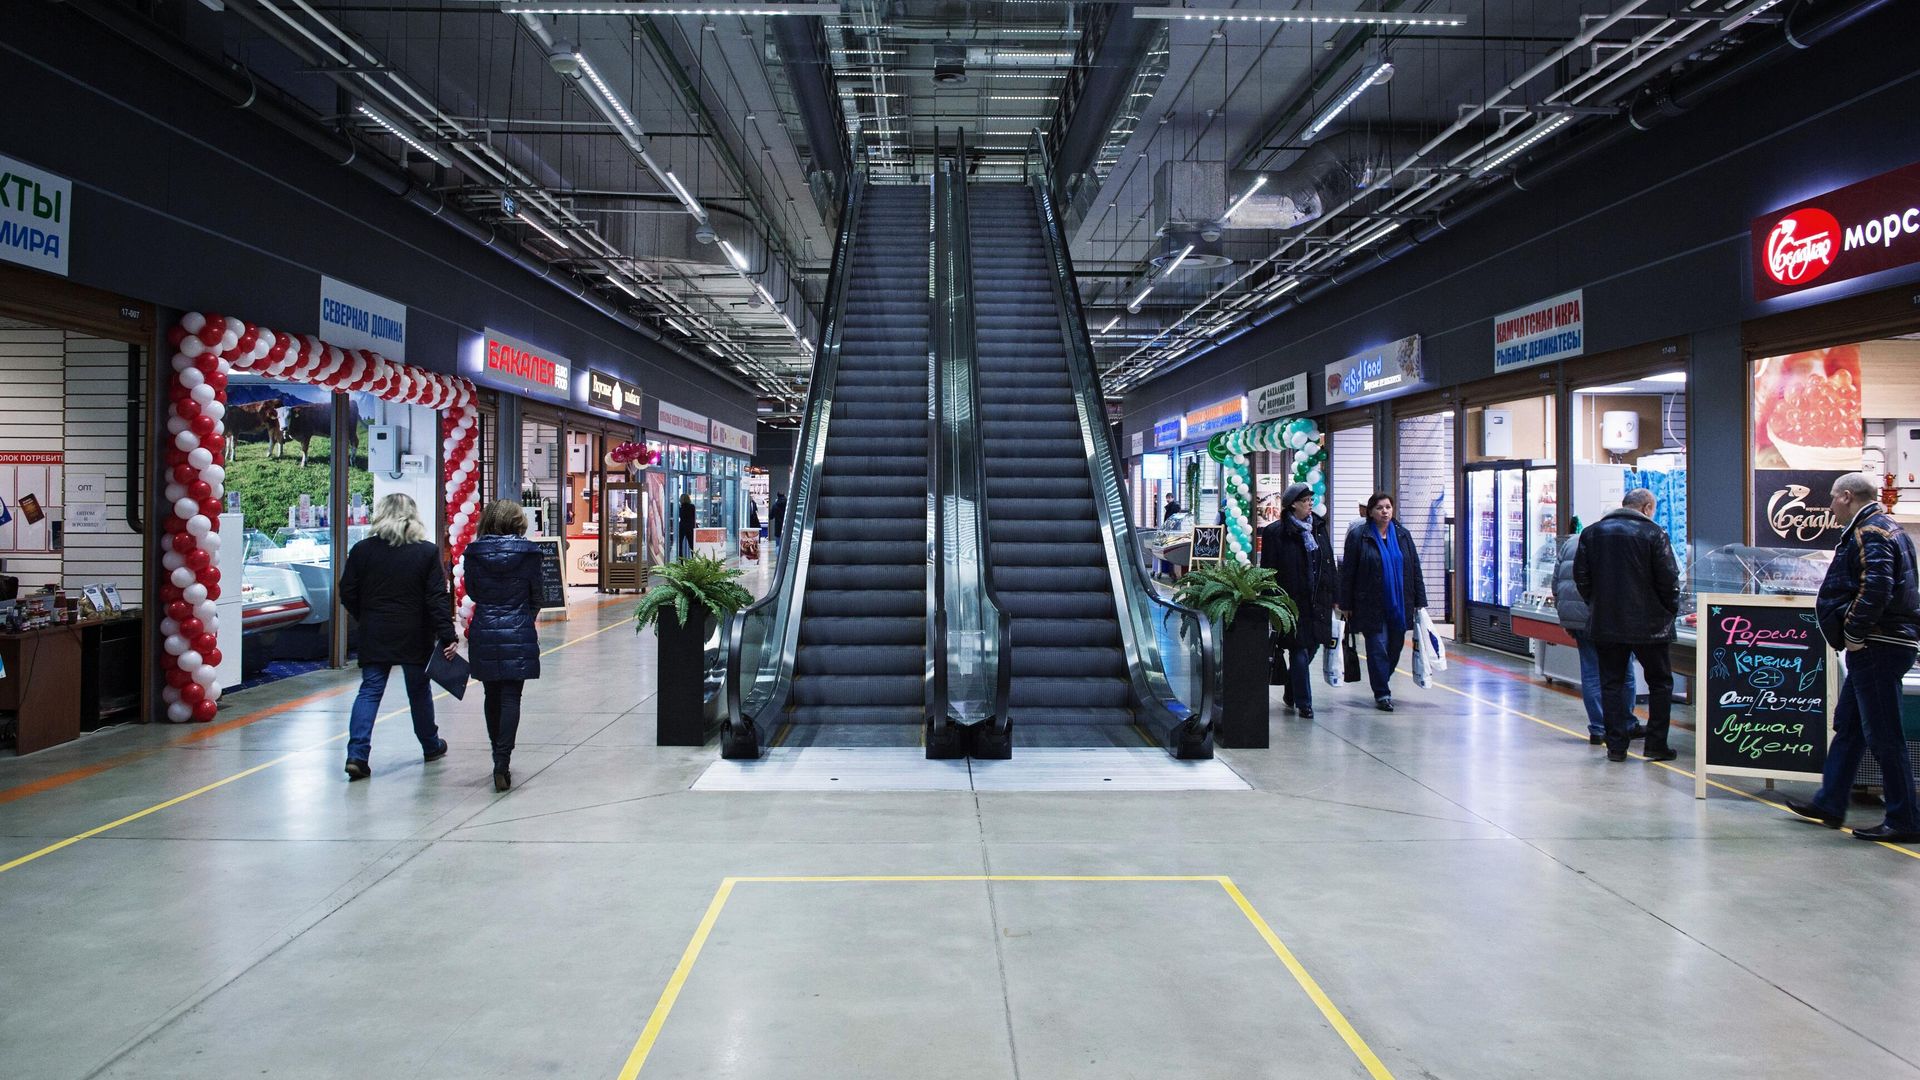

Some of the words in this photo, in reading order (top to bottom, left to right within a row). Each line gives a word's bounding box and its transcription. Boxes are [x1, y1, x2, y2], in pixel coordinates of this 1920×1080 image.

[323, 297, 369, 333] СЕВЕРНАЯ
[371, 313, 403, 343] ДОЛИНА
[1496, 307, 1553, 344] КАМЧАТСКАЯ
[1554, 300, 1581, 327] ИКРА
[488, 339, 556, 387] БАКАЛЕЯ
[1496, 343, 1527, 367] РЫБНЫЕ
[1527, 329, 1581, 362] ДЕЛИКАТЕСЫ
[1721, 616, 1808, 647] Форель
[1734, 651, 1803, 675] Карелия
[1753, 671, 1780, 685] 2+
[1714, 714, 1804, 743] Лучшая
[1738, 735, 1814, 759] Цена
